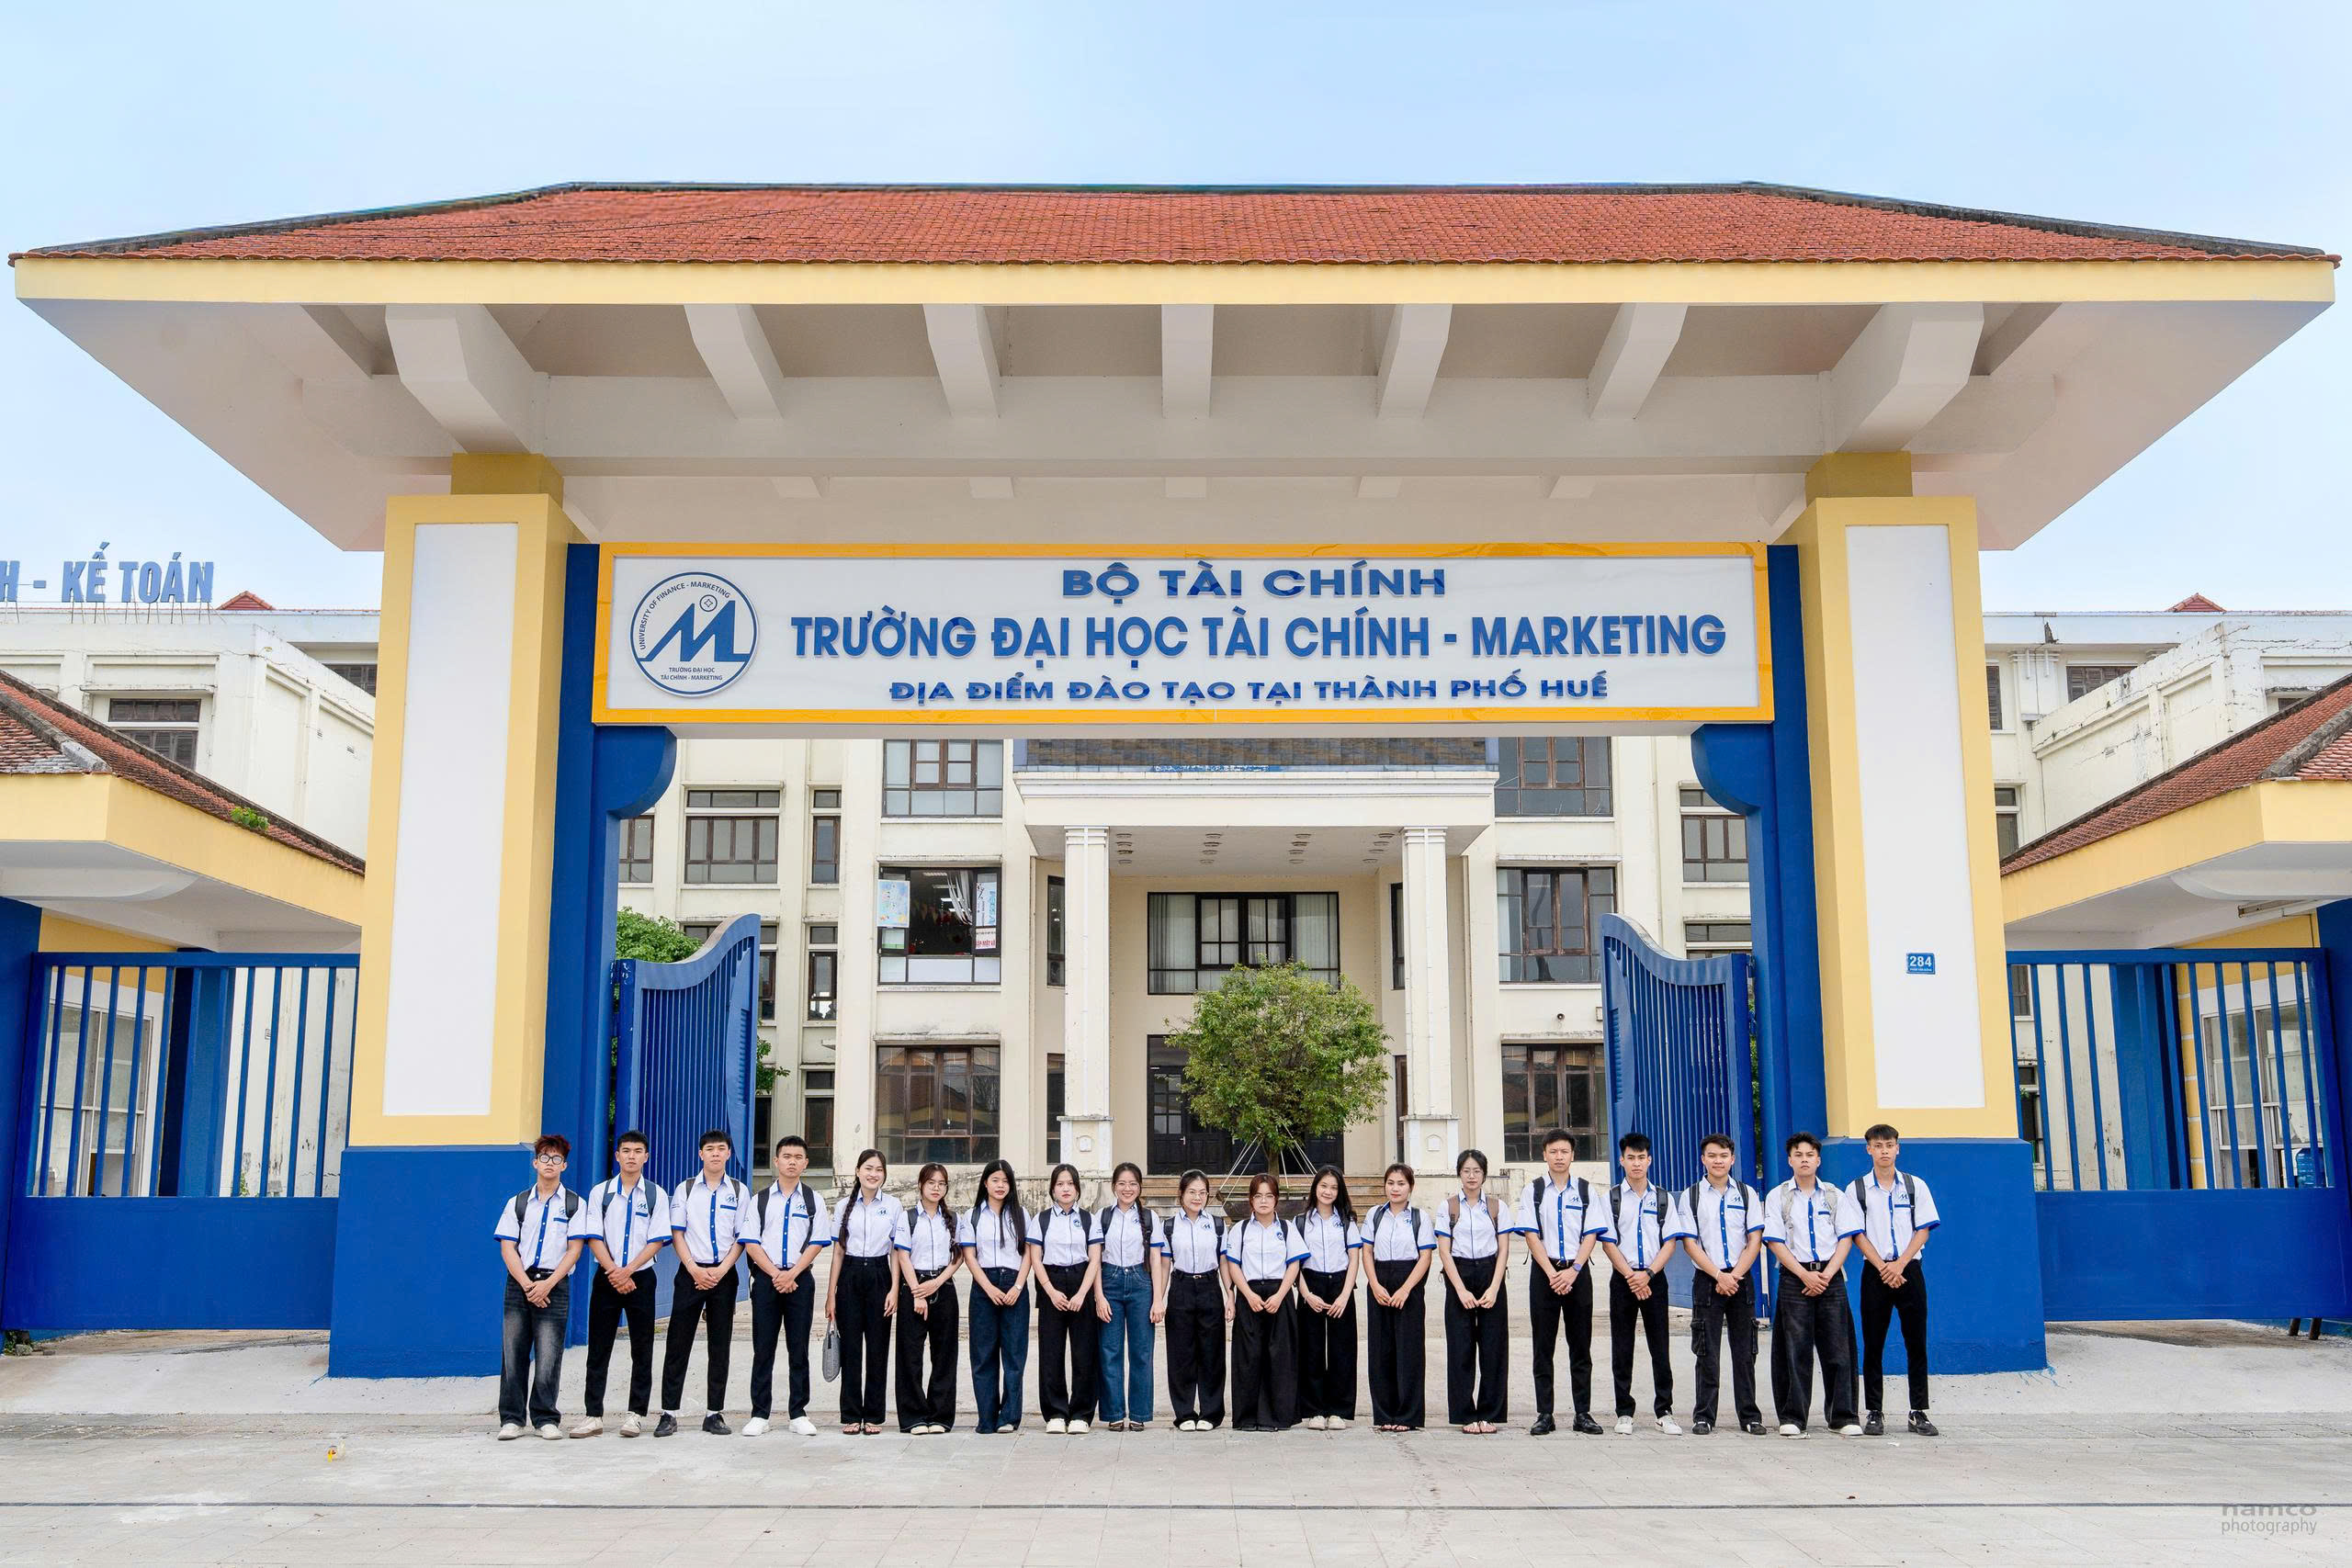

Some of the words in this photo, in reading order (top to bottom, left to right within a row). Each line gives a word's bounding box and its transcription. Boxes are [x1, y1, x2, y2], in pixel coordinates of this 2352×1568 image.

[61, 541, 110, 603] KẾ
[119, 551, 214, 604] TOÁN
[1063, 562, 1140, 604] BỘ
[1159, 561, 1242, 596] TÀI
[1263, 560, 1446, 597] CHÍNH
[639, 608, 651, 650] UNIVERSITY
[649, 599, 658, 610] OF
[656, 582, 685, 602] FINANCE
[690, 581, 731, 599] MARKETING
[791, 605, 978, 659] TRƯỜNG
[991, 616, 1071, 670] ĐẠI
[1087, 616, 1188, 670] HỌC
[1202, 606, 1270, 658] TÀI
[1285, 606, 1430, 658] CHÍNH
[1472, 614, 1726, 656] MARKETING
[889, 682, 955, 705] ĐỊA
[967, 671, 1054, 700] ĐIỂM
[1068, 675, 1151, 700] ĐÀO
[1161, 682, 1236, 705] TẠO
[1248, 682, 1303, 705] TẠI
[1314, 675, 1437, 700] THÀNH
[1451, 669, 1528, 699] PHỐ
[1540, 670, 1610, 699] HUẾ
[1910, 956, 1932, 967] 284
